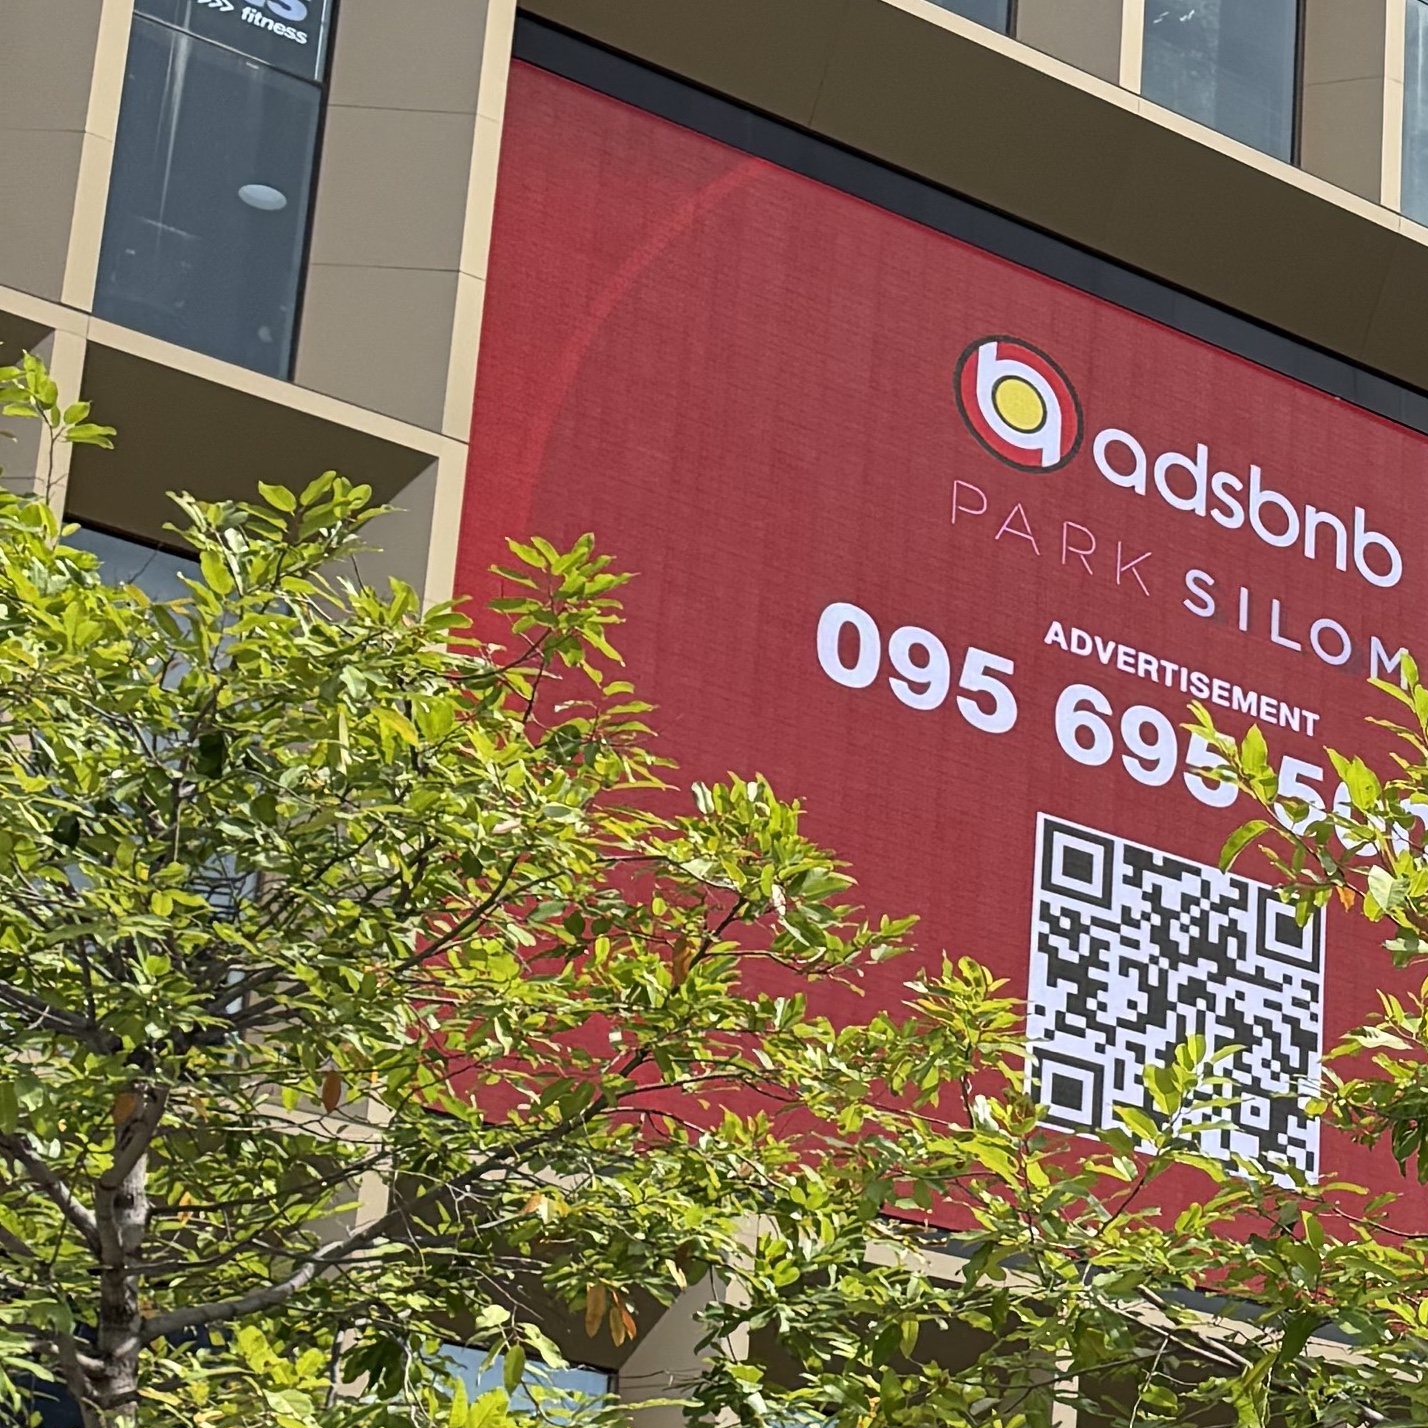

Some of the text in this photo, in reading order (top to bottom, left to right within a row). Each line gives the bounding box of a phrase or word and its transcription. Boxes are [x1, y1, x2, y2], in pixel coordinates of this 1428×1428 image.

[240, 6, 308, 45] fitness
[950, 479, 1410, 691] PARK SILOM
[1092, 427, 1403, 588] adsbnb
[816, 601, 1018, 734] 095
[1053, 683, 1243, 808] 695
[1043, 620, 1321, 738] ADVERTISEMENT
